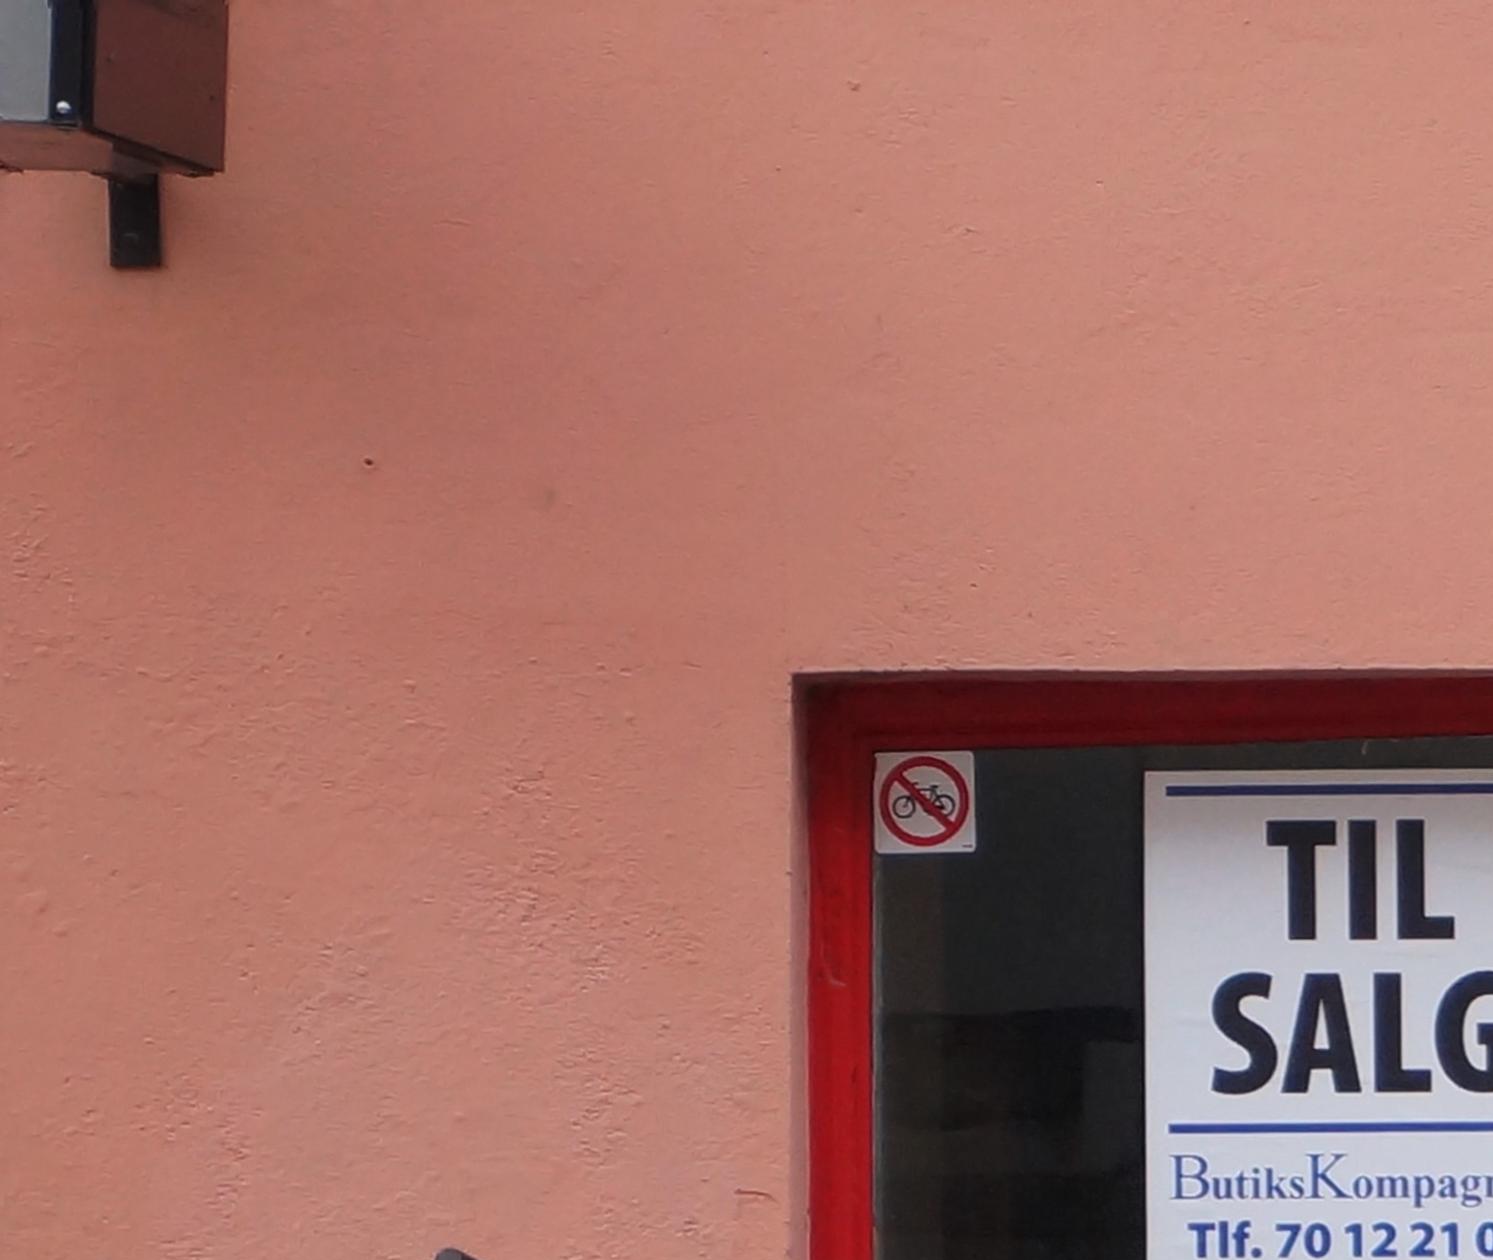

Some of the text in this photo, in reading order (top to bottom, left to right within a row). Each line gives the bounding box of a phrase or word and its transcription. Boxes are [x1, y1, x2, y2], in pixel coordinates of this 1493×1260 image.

[1266, 819, 1456, 941] TIL
[1188, 1221, 1262, 1259] Tlf.
[1275, 1223, 1332, 1258] 70
[1345, 1223, 1398, 1258] 12
[1409, 1223, 1460, 1257] 21
